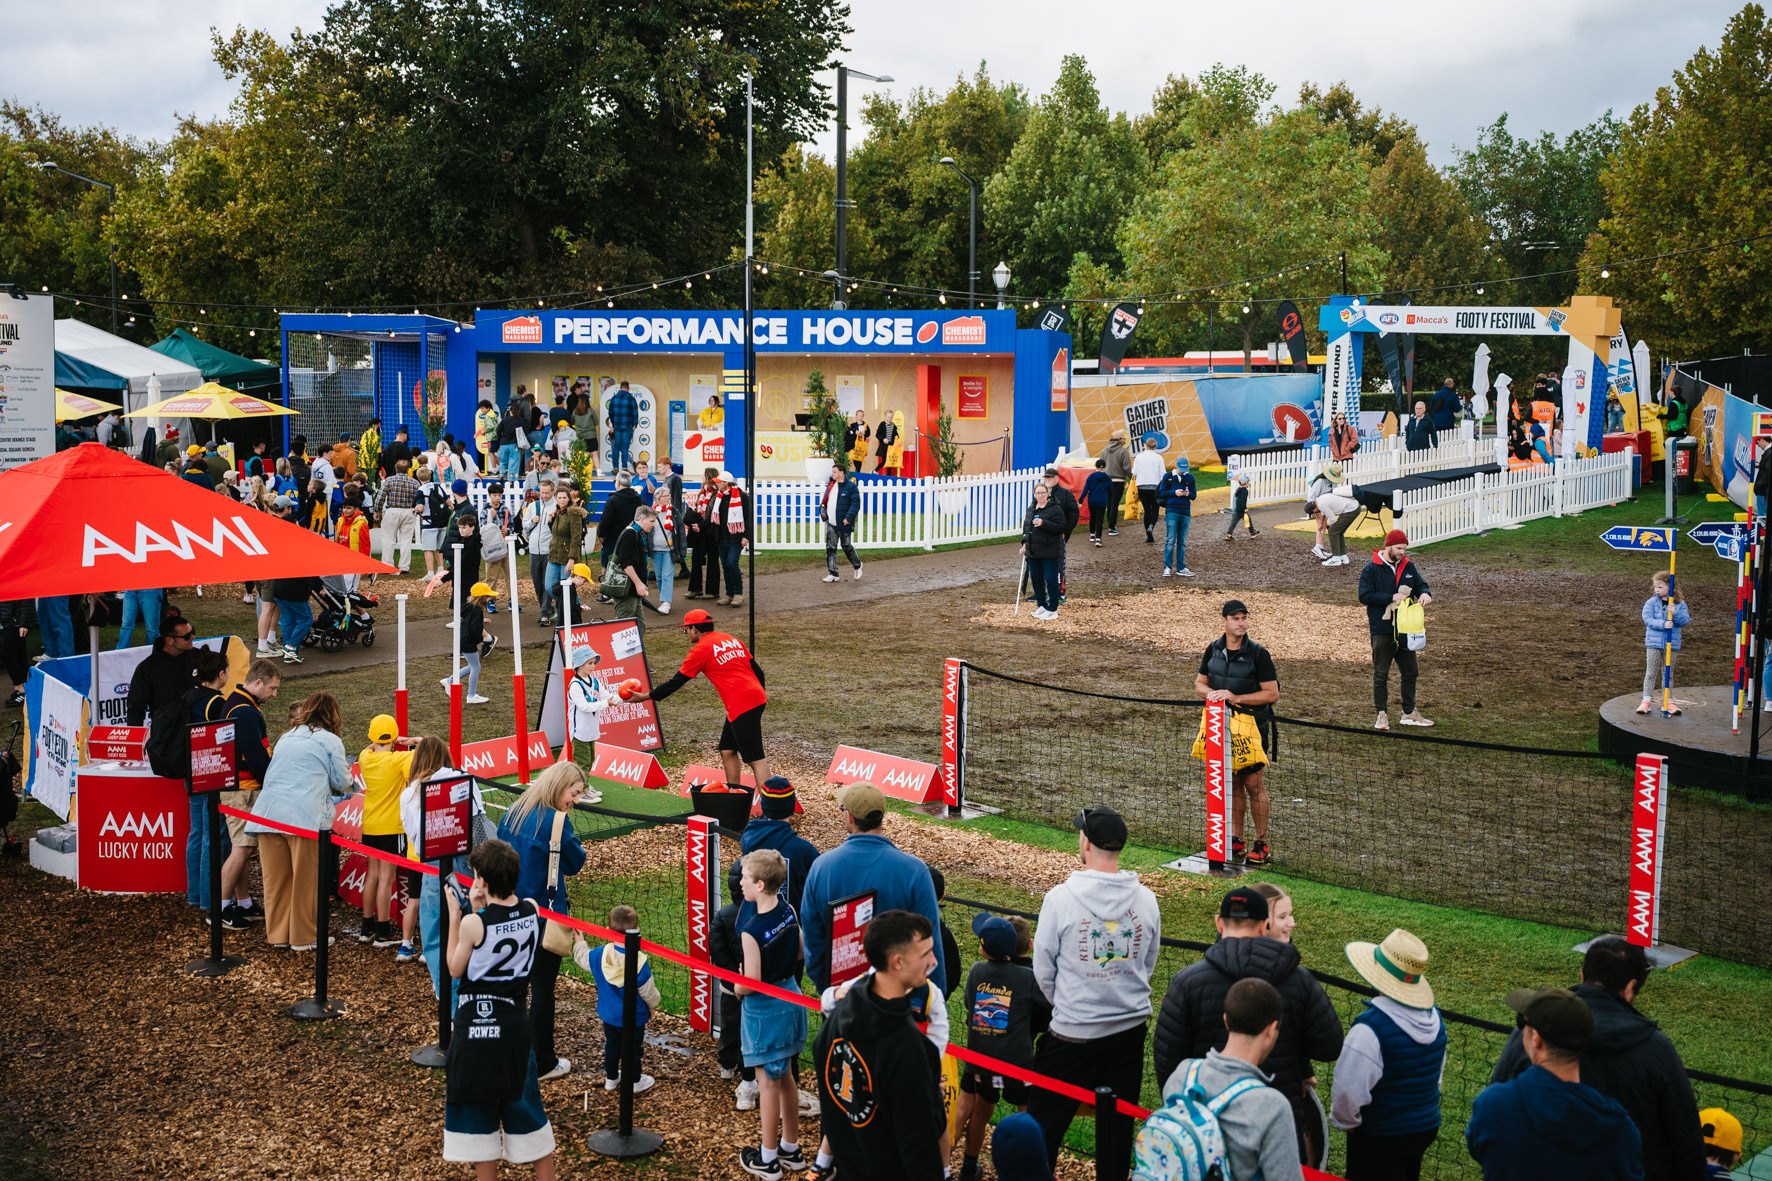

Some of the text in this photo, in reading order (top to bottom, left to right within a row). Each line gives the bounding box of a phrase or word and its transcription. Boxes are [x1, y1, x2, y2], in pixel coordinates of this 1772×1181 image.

[505, 325, 539, 335] CHEMIST
[554, 316, 913, 345] PERFORMANCE HOUSE
[945, 326, 984, 336] CHEMIST
[1416, 315, 1448, 324] Macca's
[1455, 312, 1536, 329] FOOTY FESTIVAL
[1332, 344, 1341, 387] ROUND
[1126, 400, 1166, 423] GATHER
[1129, 416, 1165, 438] ROUND
[1131, 437, 1146, 454] IT!
[82, 516, 269, 567] AAMI
[571, 632, 589, 643] AMI
[620, 629, 638, 640] AAMI
[713, 638, 744, 657] AAMI
[716, 649, 737, 666] LUCKY
[601, 667, 614, 677] BEST
[614, 666, 625, 675] KICK
[945, 666, 957, 703] AAMI
[99, 697, 128, 720] FOOT
[637, 708, 650, 718] APRIL
[111, 717, 127, 725] GAT
[638, 723, 656, 735] AAMI
[945, 714, 955, 751] AAMI
[1208, 705, 1222, 747] AAMI
[461, 741, 547, 772] AMI AMI
[604, 758, 644, 782] AAMI
[834, 758, 926, 791] AAMI AAMI
[945, 762, 955, 799] AAMI
[1209, 759, 1222, 800] AAMI
[426, 783, 441, 792] AAMI
[1638, 765, 1658, 814] AAMI
[99, 811, 174, 838] AAMI
[1210, 812, 1223, 854] AAMI
[98, 841, 174, 859] LUCKY KICK
[690, 829, 705, 883] AAMI
[1635, 827, 1654, 876] AAMI
[691, 899, 706, 952] AAMI
[1632, 889, 1651, 939] AAMI
[495, 918, 535, 935] FRENCH
[1125, 909, 1143, 960] SUMMER
[484, 930, 536, 977] 21
[692, 968, 709, 1022] AAMI
[976, 982, 1013, 996] Ghanda
[468, 1026, 500, 1039] POWER
